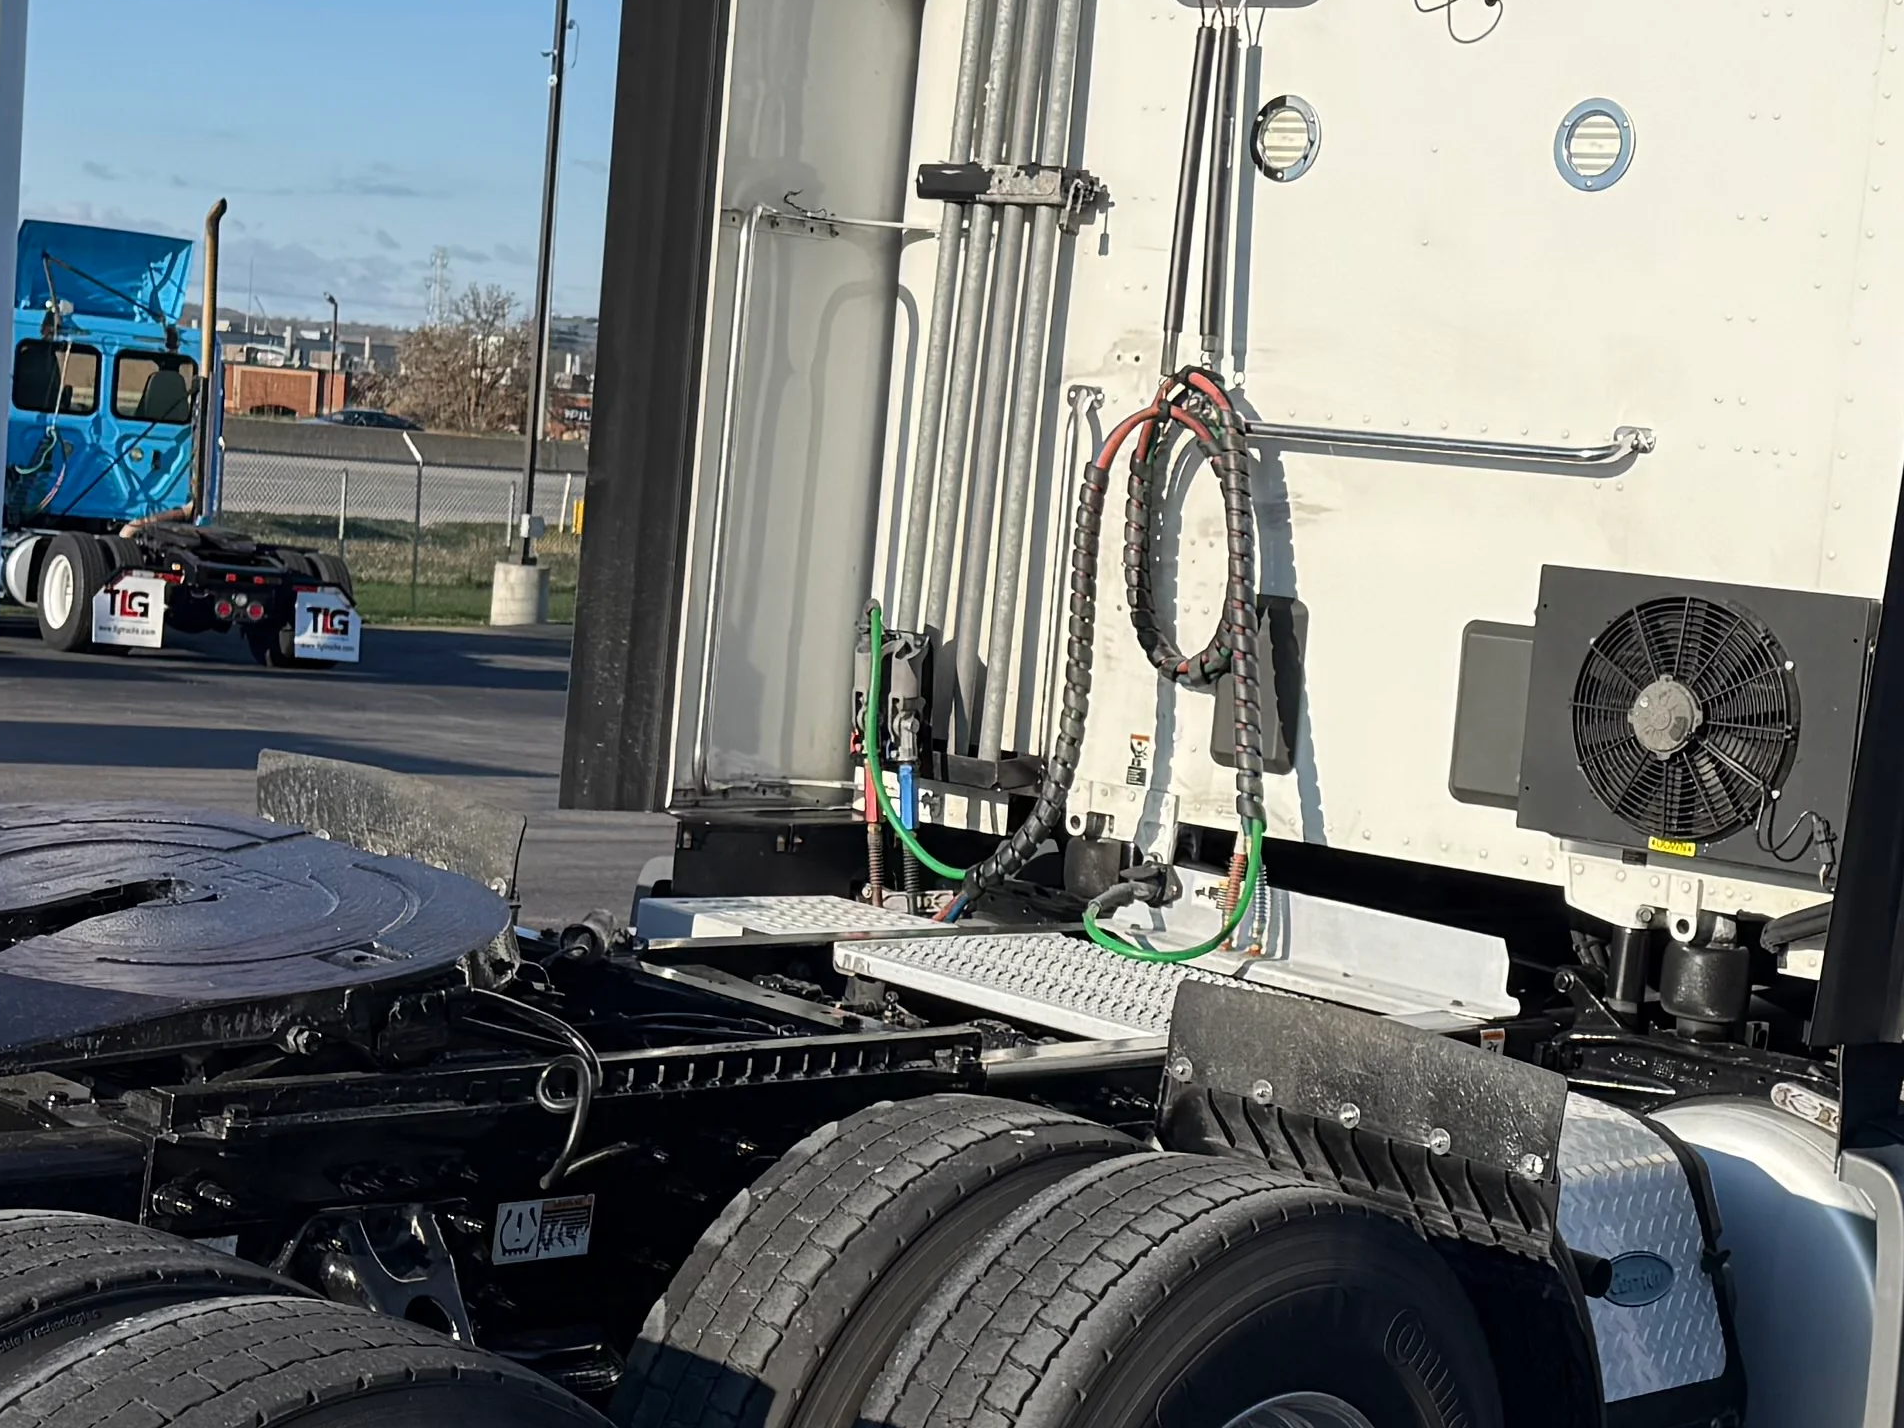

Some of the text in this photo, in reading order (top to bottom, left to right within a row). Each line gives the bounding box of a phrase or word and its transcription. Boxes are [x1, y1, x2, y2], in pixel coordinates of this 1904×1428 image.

[104, 589, 149, 618] TLG
[306, 606, 350, 635] TLG
[24, 1308, 102, 1341] Technologies
